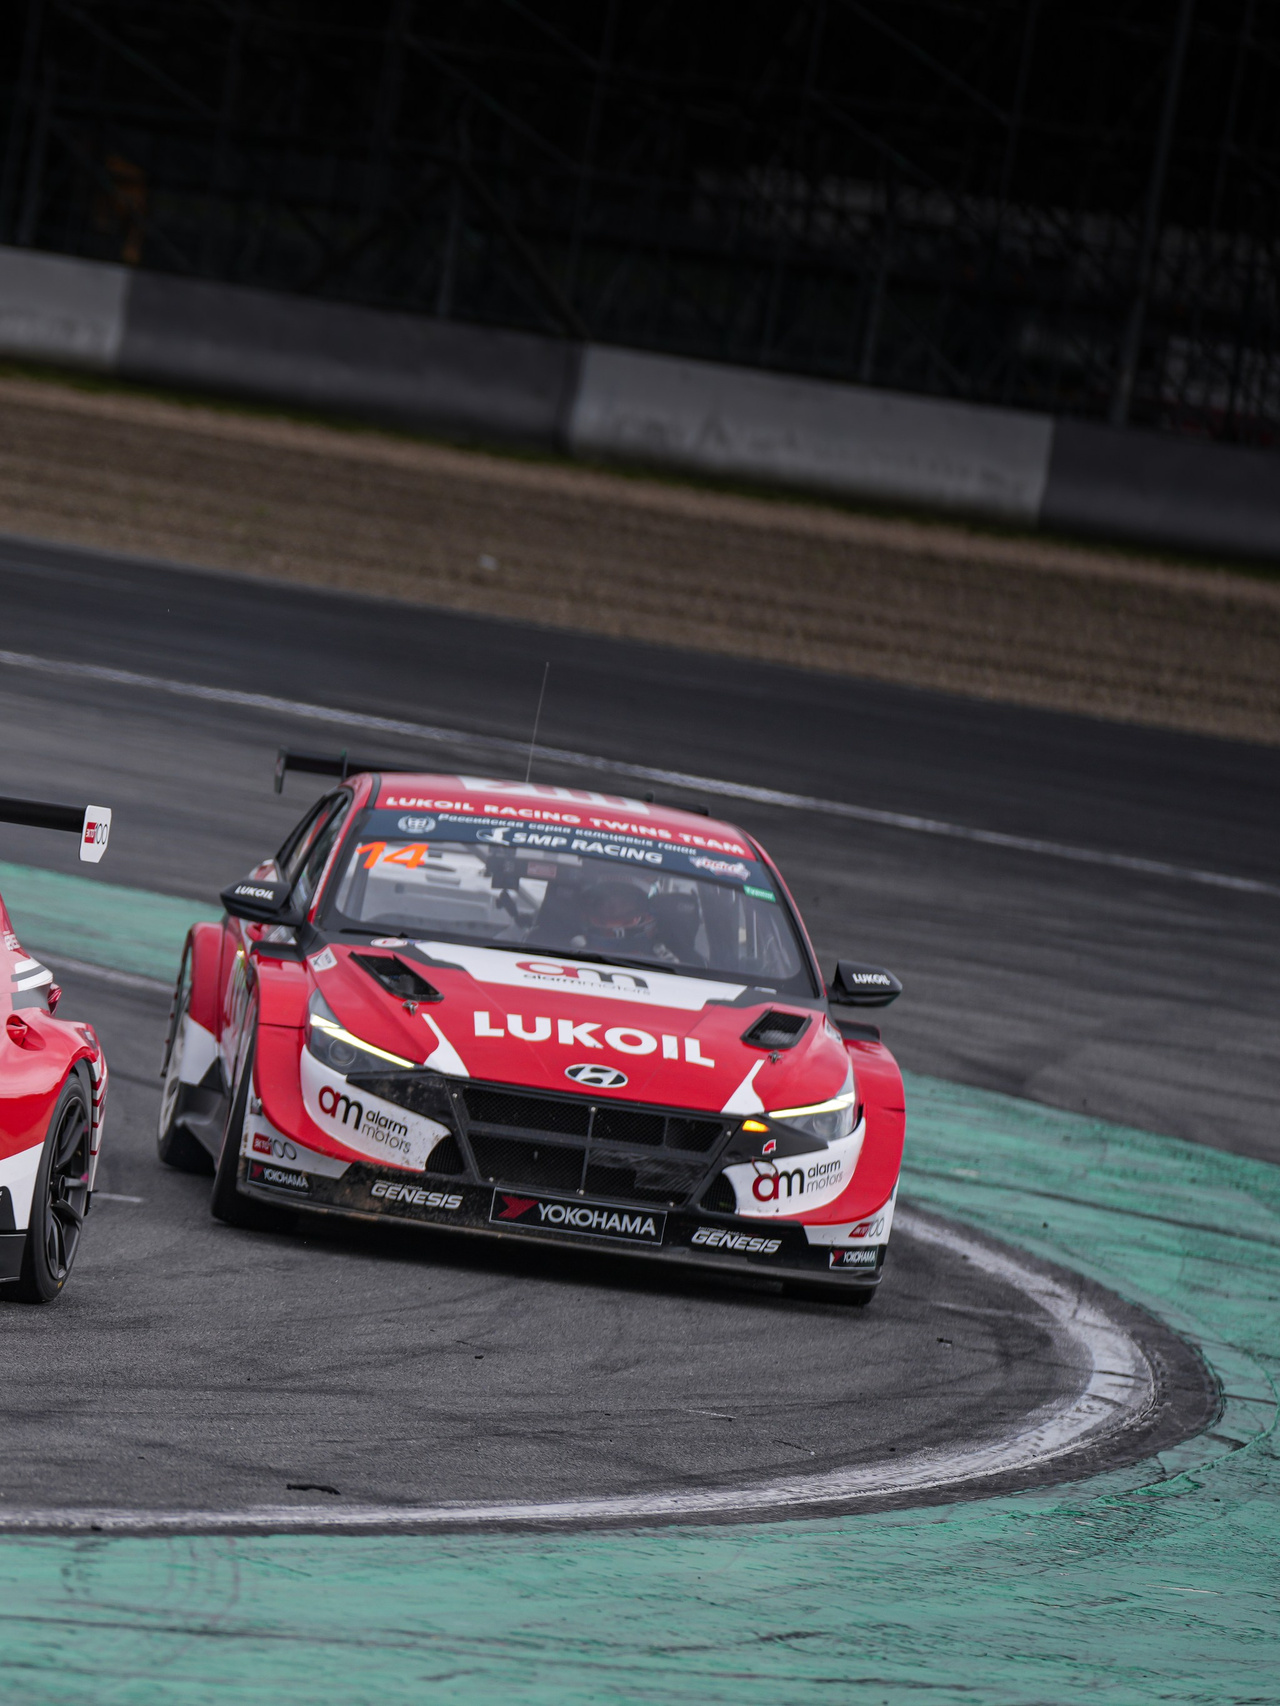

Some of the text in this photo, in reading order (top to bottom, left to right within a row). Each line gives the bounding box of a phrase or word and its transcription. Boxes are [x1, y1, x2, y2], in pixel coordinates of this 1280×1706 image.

[386, 796, 746, 855] LUKOIL RACING TWINS TEAM
[355, 841, 429, 869] 14
[512, 832, 664, 865] SMP RACING
[234, 885, 275, 901] LUKOIL
[852, 973, 890, 986] LUKOIL
[473, 1010, 715, 1069] LUKOIL
[366, 1109, 409, 1137] alarm
[361, 1123, 412, 1155] motors
[263, 1167, 309, 1189] YOKOHAMA
[806, 1171, 844, 1193] motors
[807, 1159, 841, 1178] alarm
[371, 1182, 464, 1210] GENESIS
[538, 1202, 657, 1237] YOKOHAMA
[691, 1229, 782, 1254] GENESIS
[843, 1250, 876, 1263] YOKOHAMA
